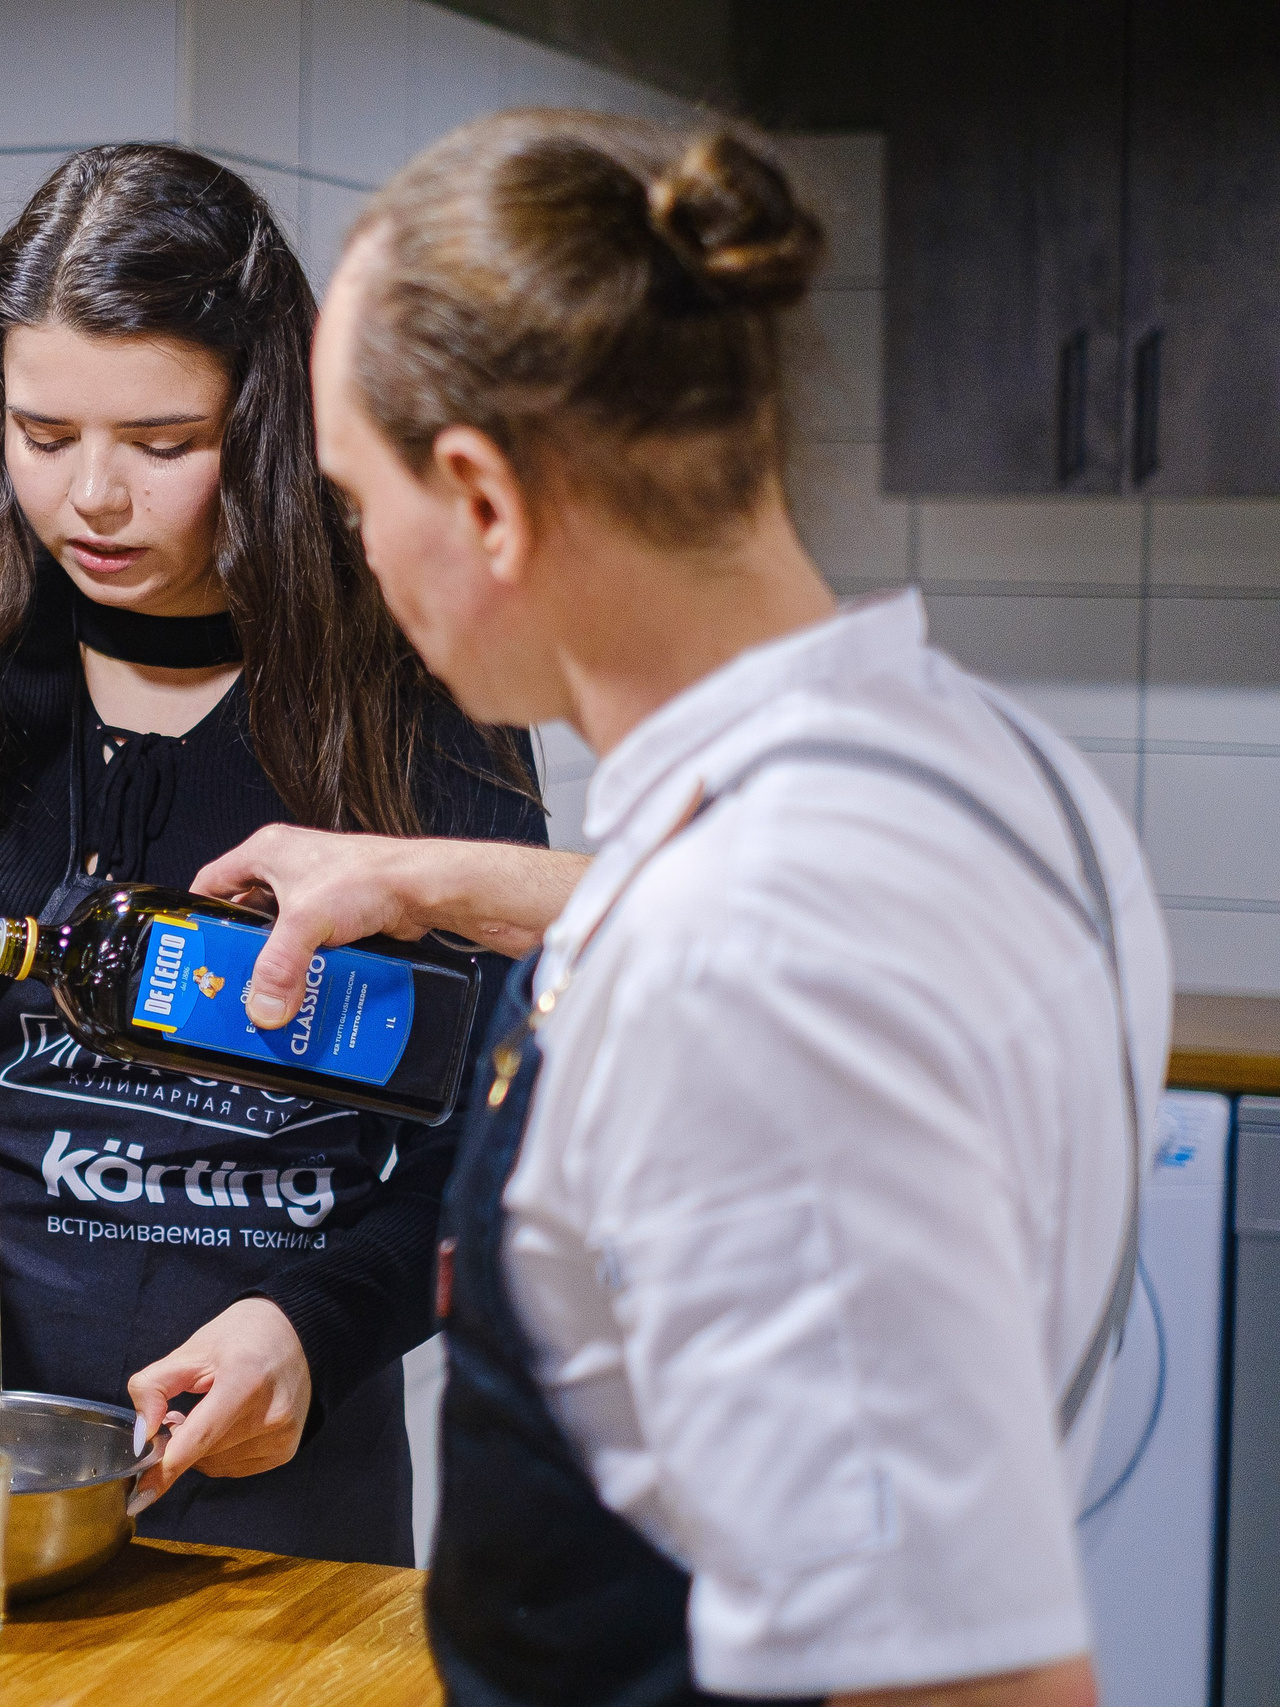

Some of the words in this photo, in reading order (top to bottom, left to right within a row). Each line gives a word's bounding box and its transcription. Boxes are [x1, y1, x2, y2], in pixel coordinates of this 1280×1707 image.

[150, 934, 185, 990] CECCO
[345, 970, 356, 994] CUCINA
[144, 989, 174, 1015] DE
[290, 955, 326, 1055] CLASSICO
[348, 1014, 361, 1048] ESTRATTO
[357, 982, 367, 1009] FREDDO
[332, 1043, 340, 1055] PER
[335, 1023, 344, 1042] TUTTI
[69, 1072, 232, 1115] КУЛИНАРНАЯ
[42, 1130, 335, 1227] körting
[47, 1216, 231, 1247] встраиваемая
[239, 1229, 326, 1250] техника
